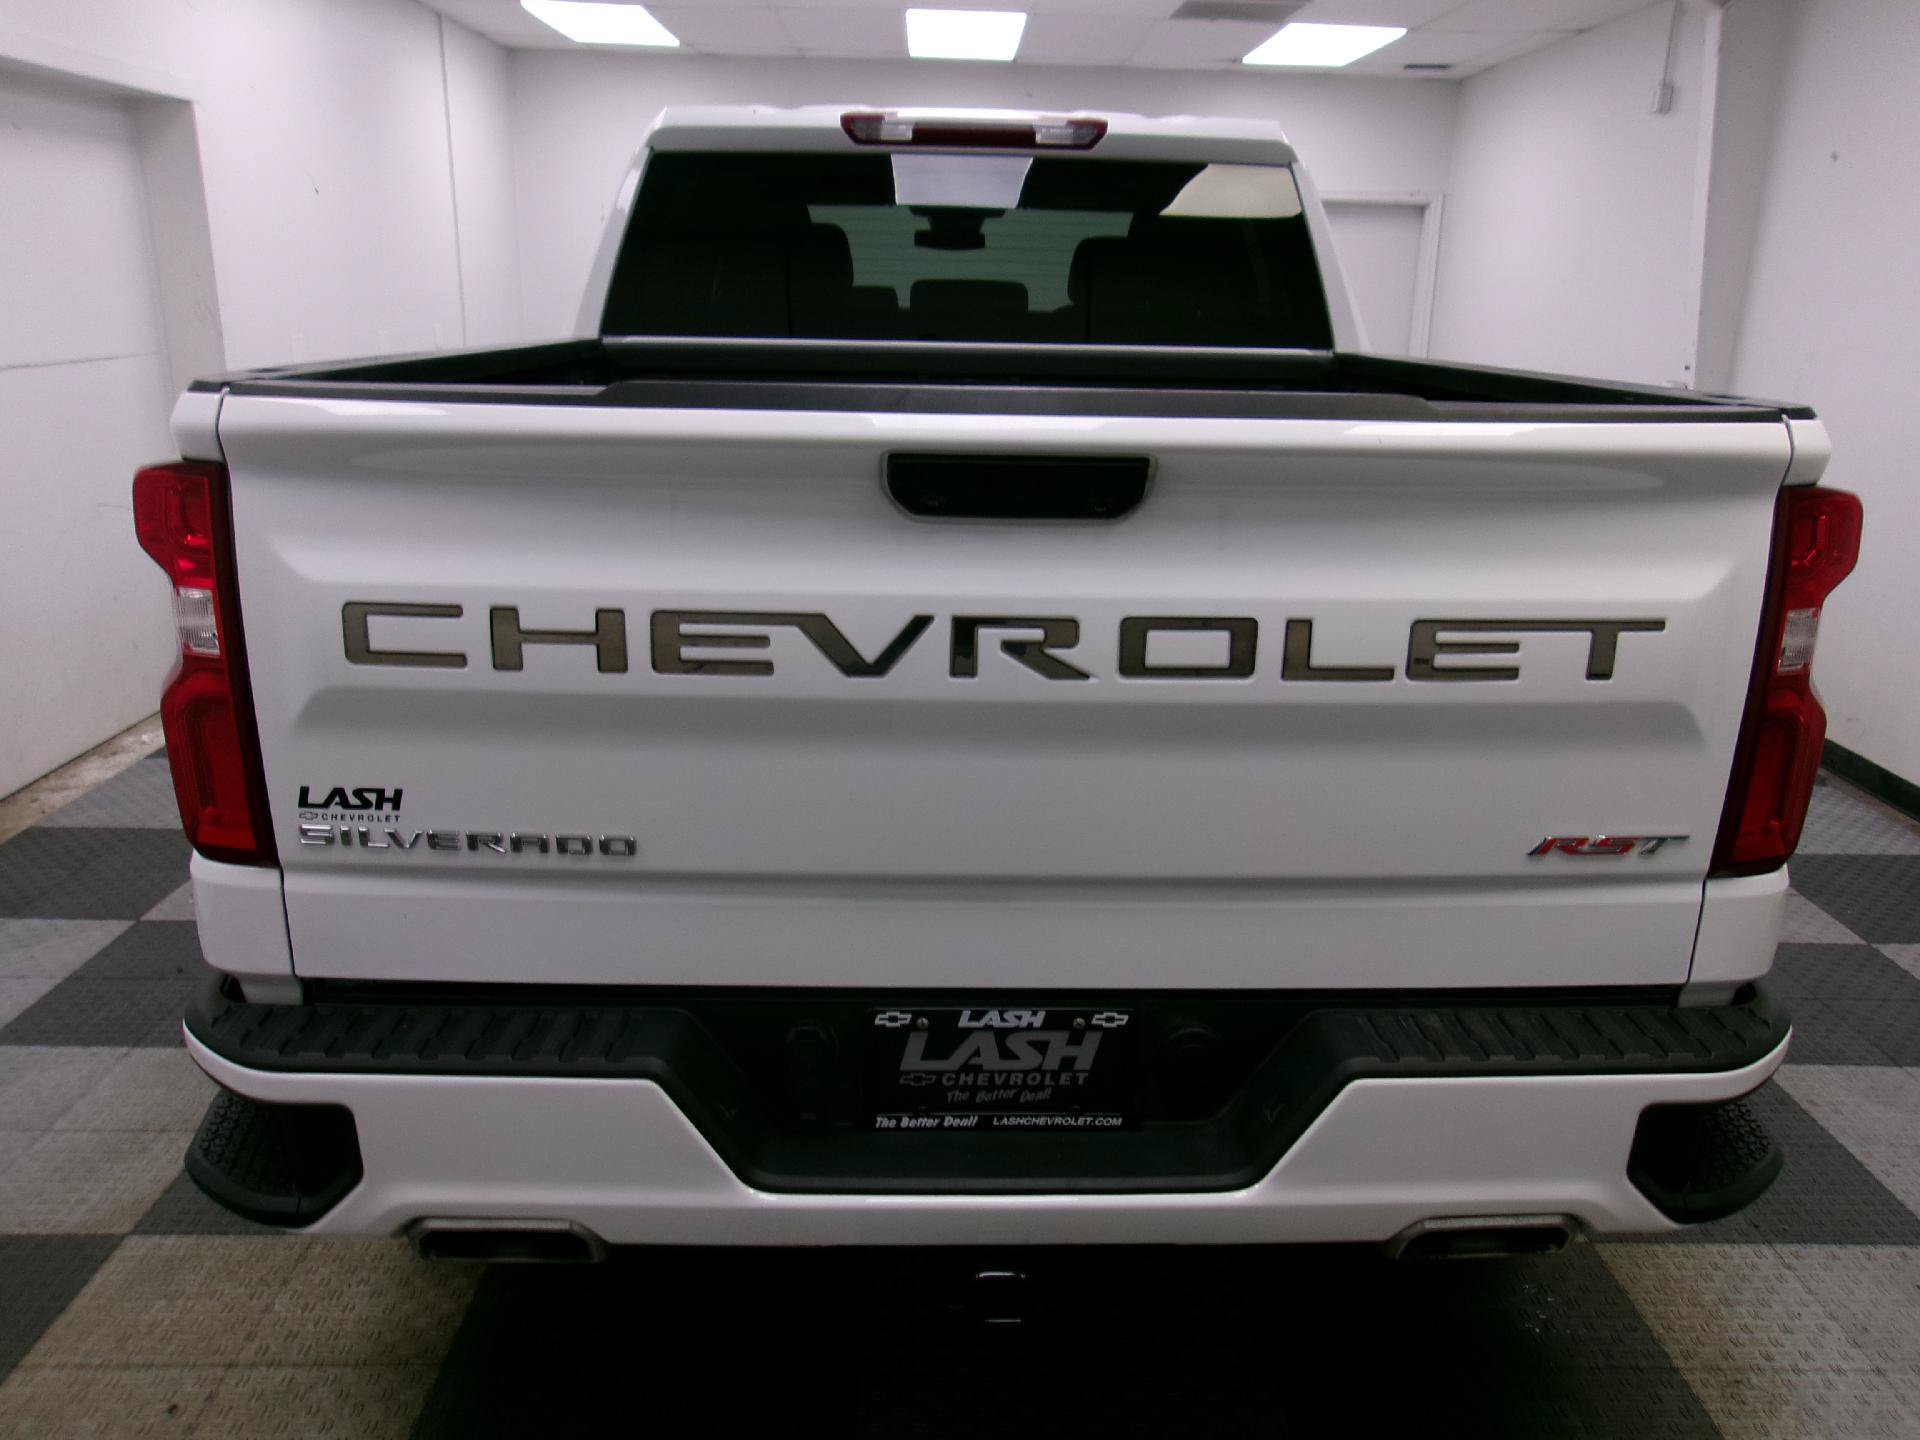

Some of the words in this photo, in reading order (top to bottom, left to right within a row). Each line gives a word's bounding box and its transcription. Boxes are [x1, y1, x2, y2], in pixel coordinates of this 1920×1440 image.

[342, 601, 1666, 682] CHEVROLET
[298, 786, 403, 811] LASH
[321, 813, 401, 823] CHEVROLET
[300, 823, 637, 856] SILVERADO
[1528, 834, 1690, 857] RST
[957, 1010, 1046, 1028] LASH
[899, 1031, 1103, 1071] LASH
[941, 1072, 1089, 1087] CHEVROLET
[946, 1089, 970, 1104] The
[976, 1088, 1019, 1103] Better
[875, 1116, 897, 1128] The
[900, 1116, 939, 1128] Better
[992, 1116, 1123, 1126] LASHCHEVROLET.COM
